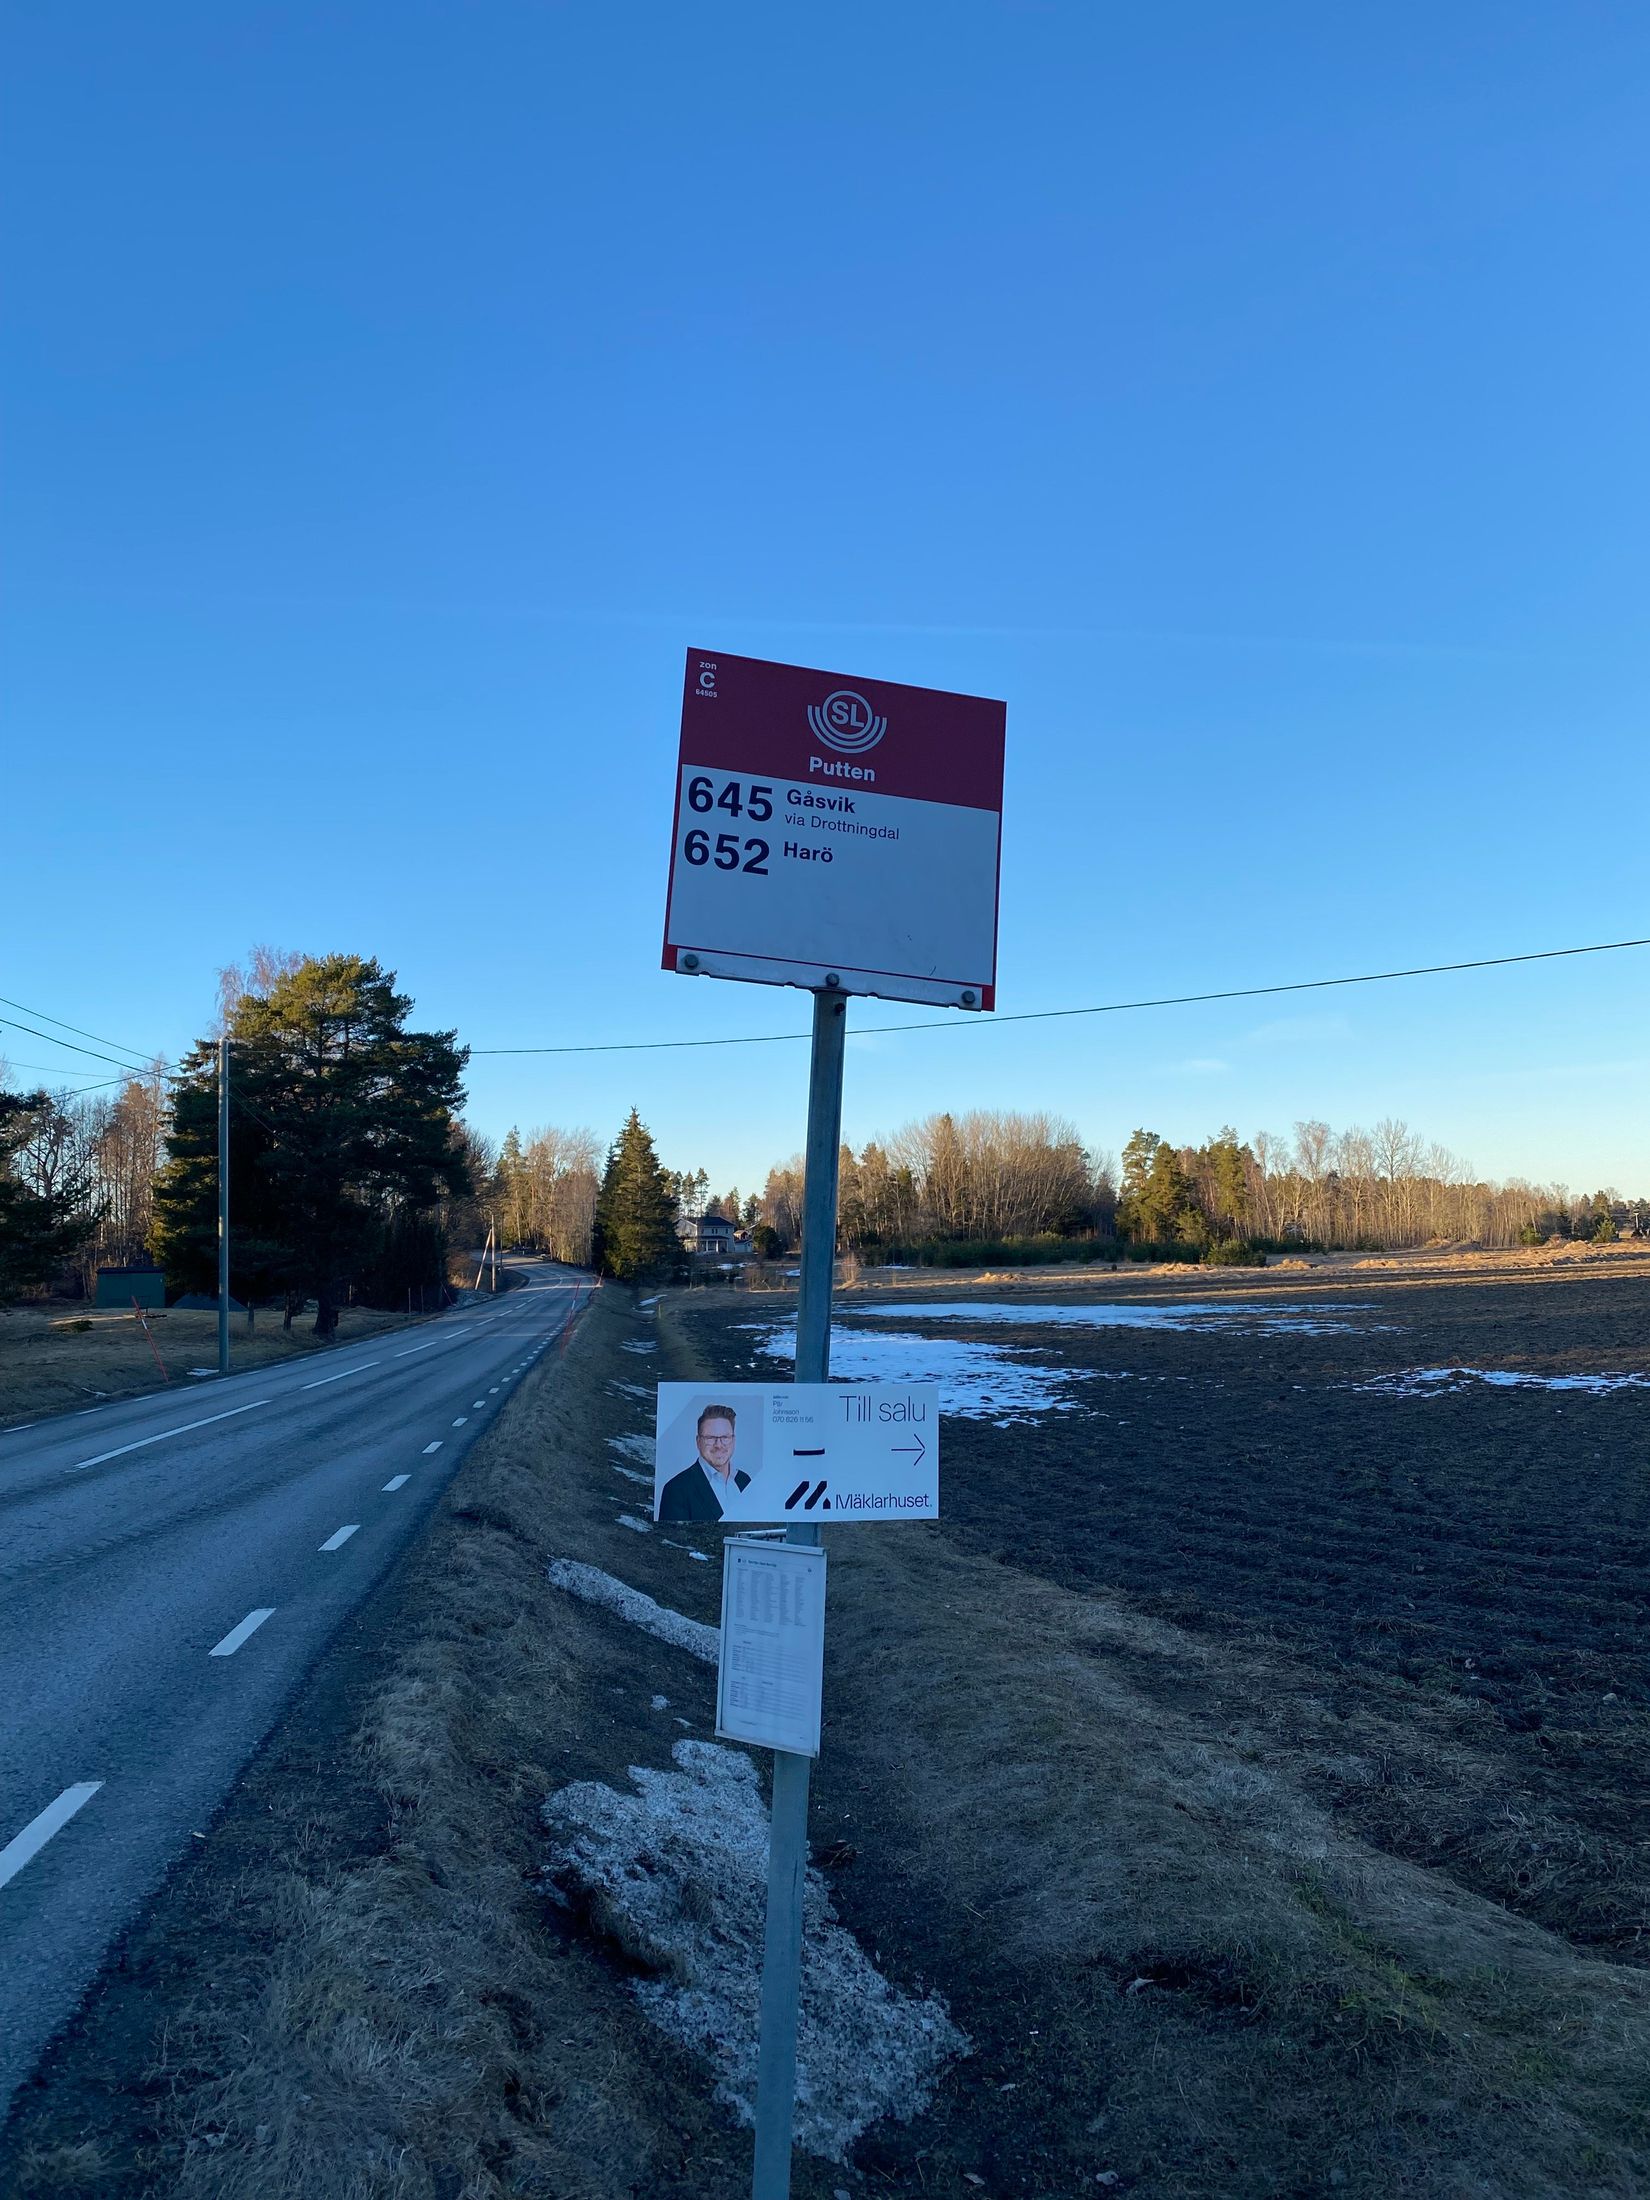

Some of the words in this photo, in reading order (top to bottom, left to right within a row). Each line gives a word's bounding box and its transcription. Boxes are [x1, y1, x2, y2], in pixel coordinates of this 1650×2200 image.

[699, 661, 717, 670] zon
[700, 671, 715, 688] C
[831, 700, 865, 728] SL
[809, 756, 876, 782] Putten
[687, 776, 774, 822] 645
[786, 788, 856, 814] Gåsvik
[784, 813, 806, 827] via
[810, 815, 900, 840] Drottningdal
[683, 829, 770, 876] 652
[783, 841, 834, 863] Harö
[839, 1395, 872, 1422] Till
[879, 1395, 926, 1422] salu
